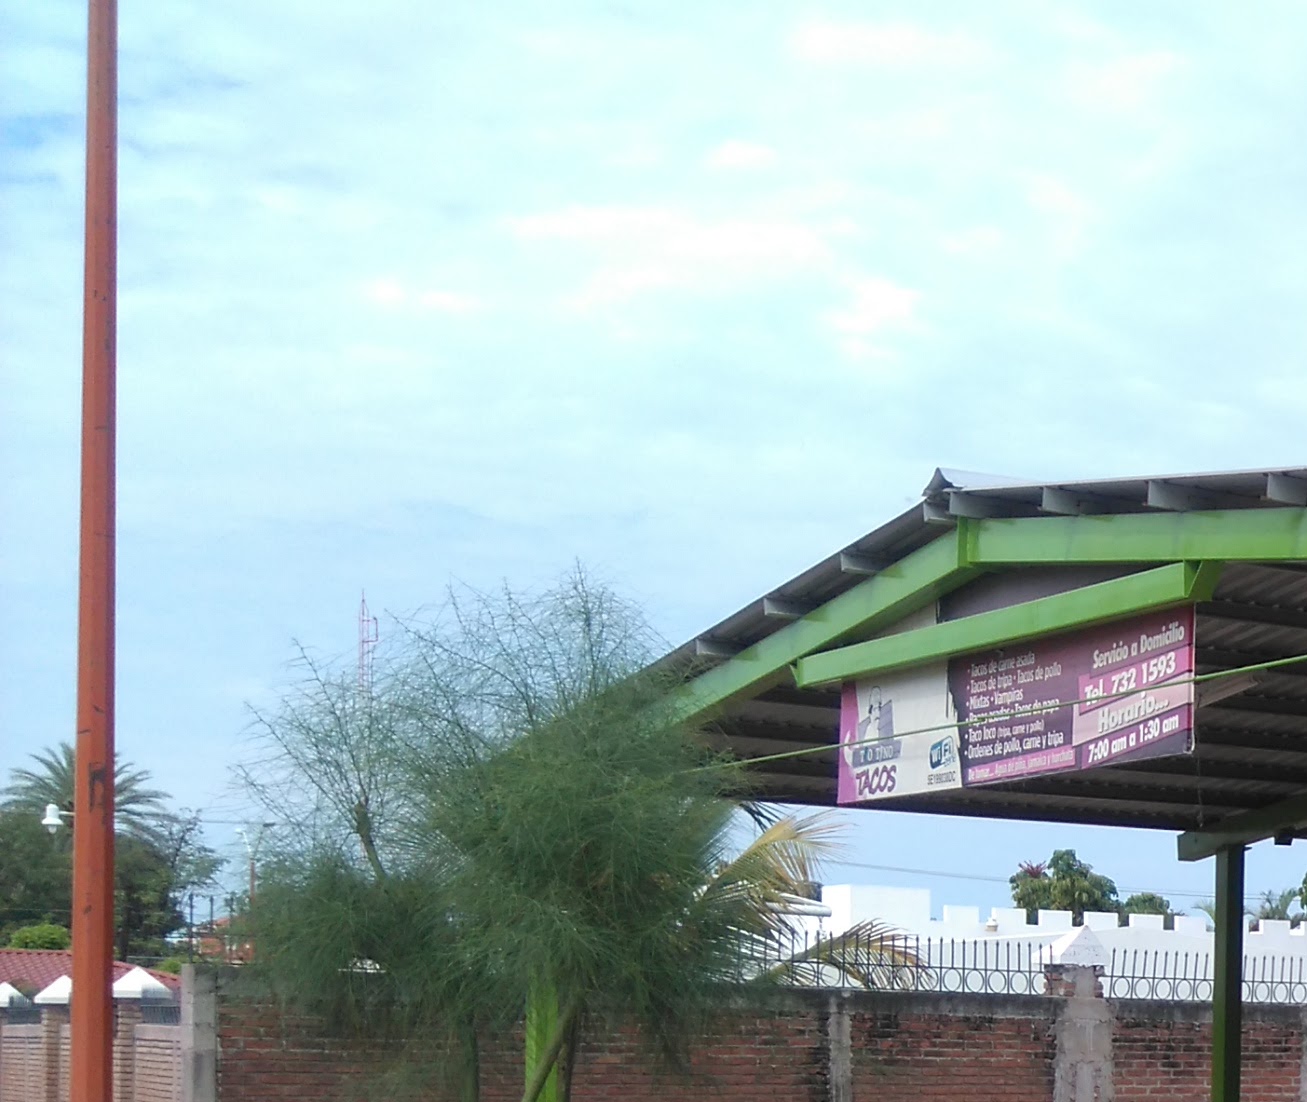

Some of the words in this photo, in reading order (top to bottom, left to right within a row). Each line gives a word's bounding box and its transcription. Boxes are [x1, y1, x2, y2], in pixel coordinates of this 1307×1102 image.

[1093, 640, 1128, 669] Servicio
[1131, 644, 1138, 656] a
[1140, 621, 1184, 653] Domicilio
[970, 680, 987, 694] Tacos
[997, 672, 1012, 689] tripa
[1017, 670, 1034, 684] Tacos
[971, 664, 987, 677] Tacos
[1084, 678, 1107, 706] Tel.
[1111, 668, 1136, 693] 732
[1142, 652, 1176, 684] 1593
[968, 728, 982, 742] Taco
[983, 726, 996, 740] loco
[994, 740, 1002, 754] de
[1022, 736, 1040, 750] carne
[1048, 730, 1064, 746] tripa
[1088, 738, 1110, 763] 7:00
[1111, 737, 1126, 750] am
[1129, 732, 1136, 748] a
[1139, 718, 1160, 743] 1:30
[1162, 714, 1178, 733] am
[856, 764, 897, 796] TACOS
